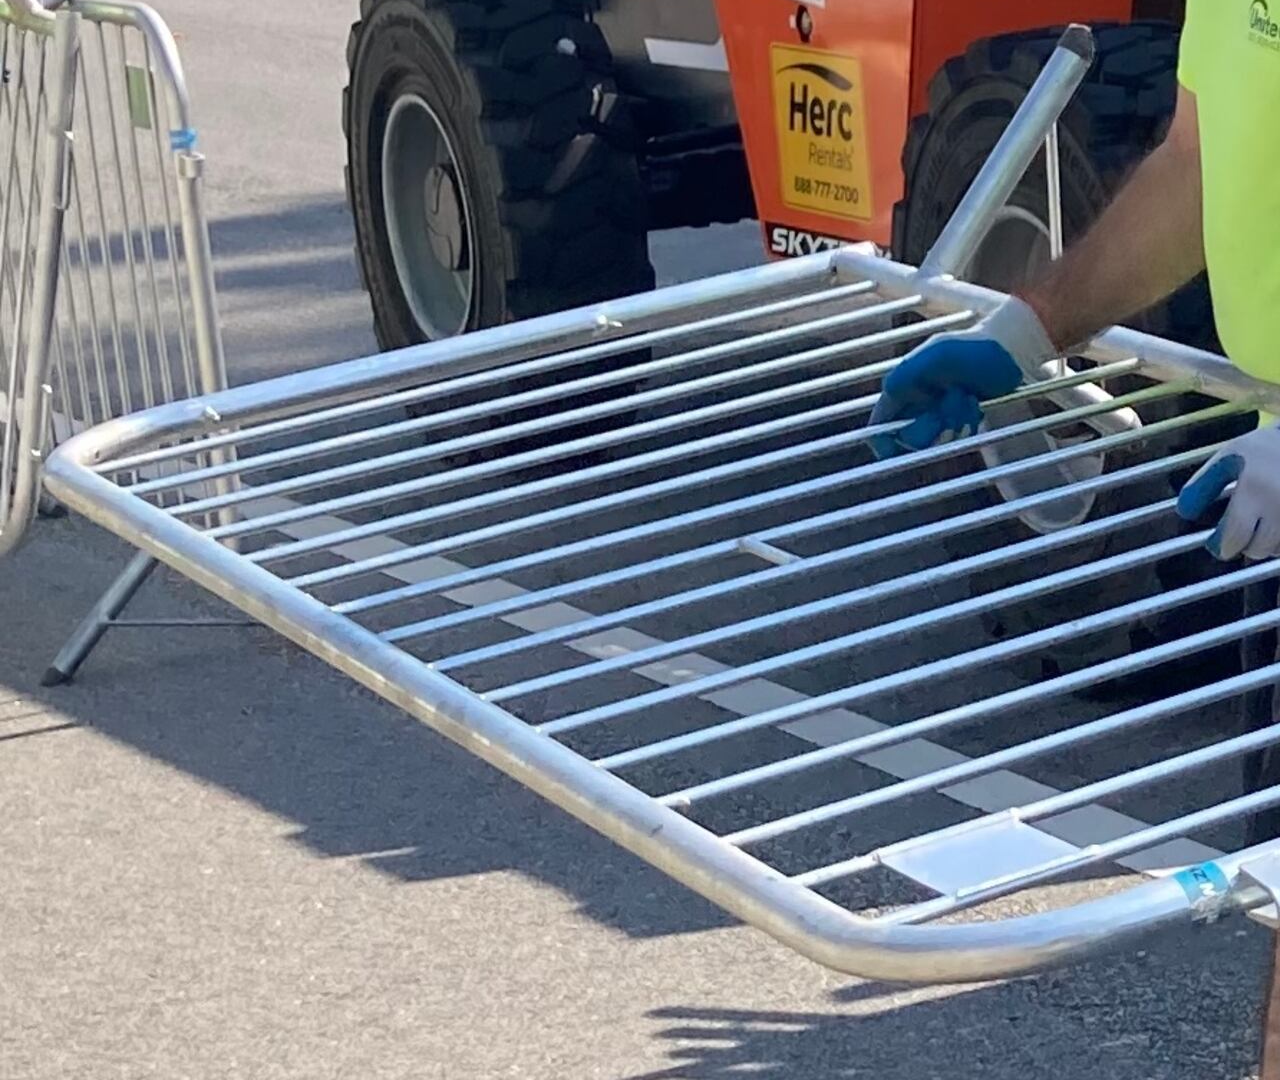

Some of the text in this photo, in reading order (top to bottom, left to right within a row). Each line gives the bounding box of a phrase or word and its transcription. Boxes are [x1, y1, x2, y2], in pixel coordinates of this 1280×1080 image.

[789, 81, 853, 142] Herc
[808, 141, 853, 172] Rentals
[794, 175, 859, 204] 888-777-2700
[772, 226, 892, 260] SKYT
